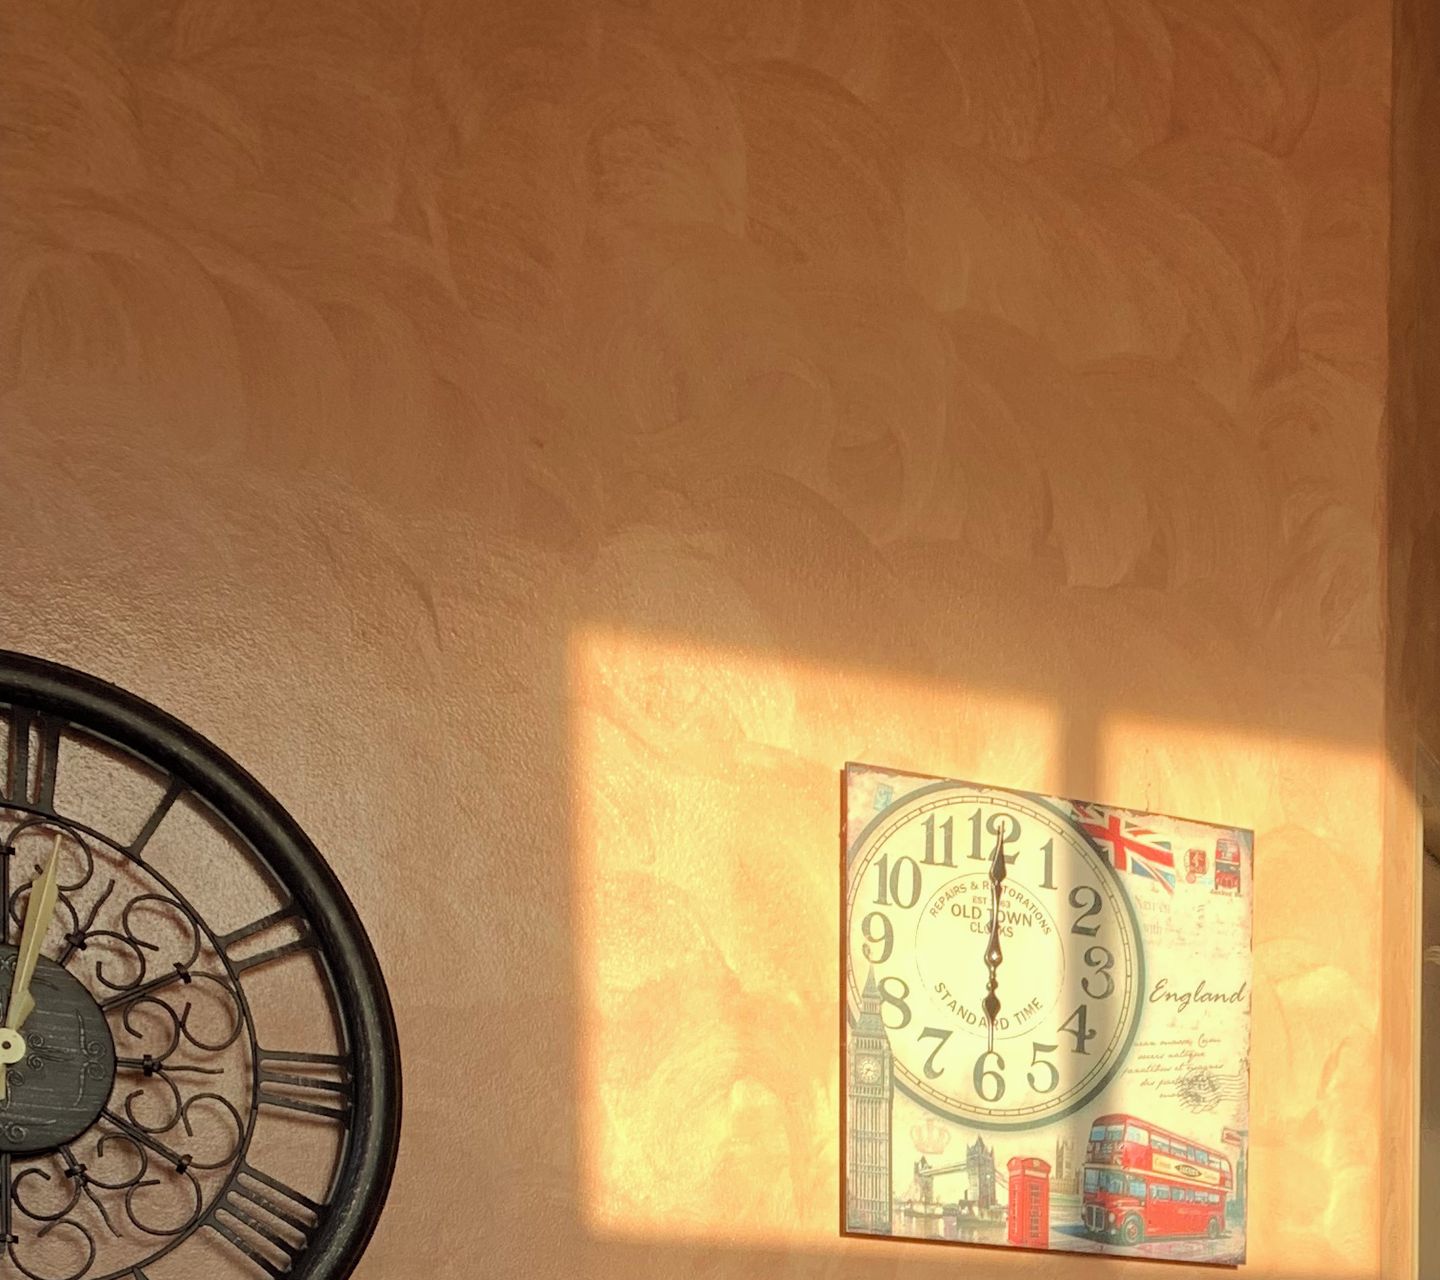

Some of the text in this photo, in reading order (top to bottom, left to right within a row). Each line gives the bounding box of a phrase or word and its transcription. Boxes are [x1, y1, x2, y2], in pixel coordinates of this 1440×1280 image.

[919, 812, 959, 869] 11
[966, 807, 1021, 865] 12
[872, 852, 922, 910] 10
[1040, 837, 1058, 891] 1
[929, 880, 1052, 936] REPAIRS & RTORATIONS
[951, 903, 982, 920] OLD
[972, 896, 987, 905] EST
[1068, 885, 1103, 938] 2
[861, 911, 894, 964] 9
[1081, 945, 1115, 1000] 3
[1149, 977, 1247, 1014] England
[876, 976, 912, 1030] 8
[934, 982, 1044, 1031] STANDARD TIME
[916, 1027, 953, 1080] 7
[1057, 1004, 1097, 1056] 4
[972, 1051, 1006, 1102] 6
[1026, 1042, 1060, 1094] 5
